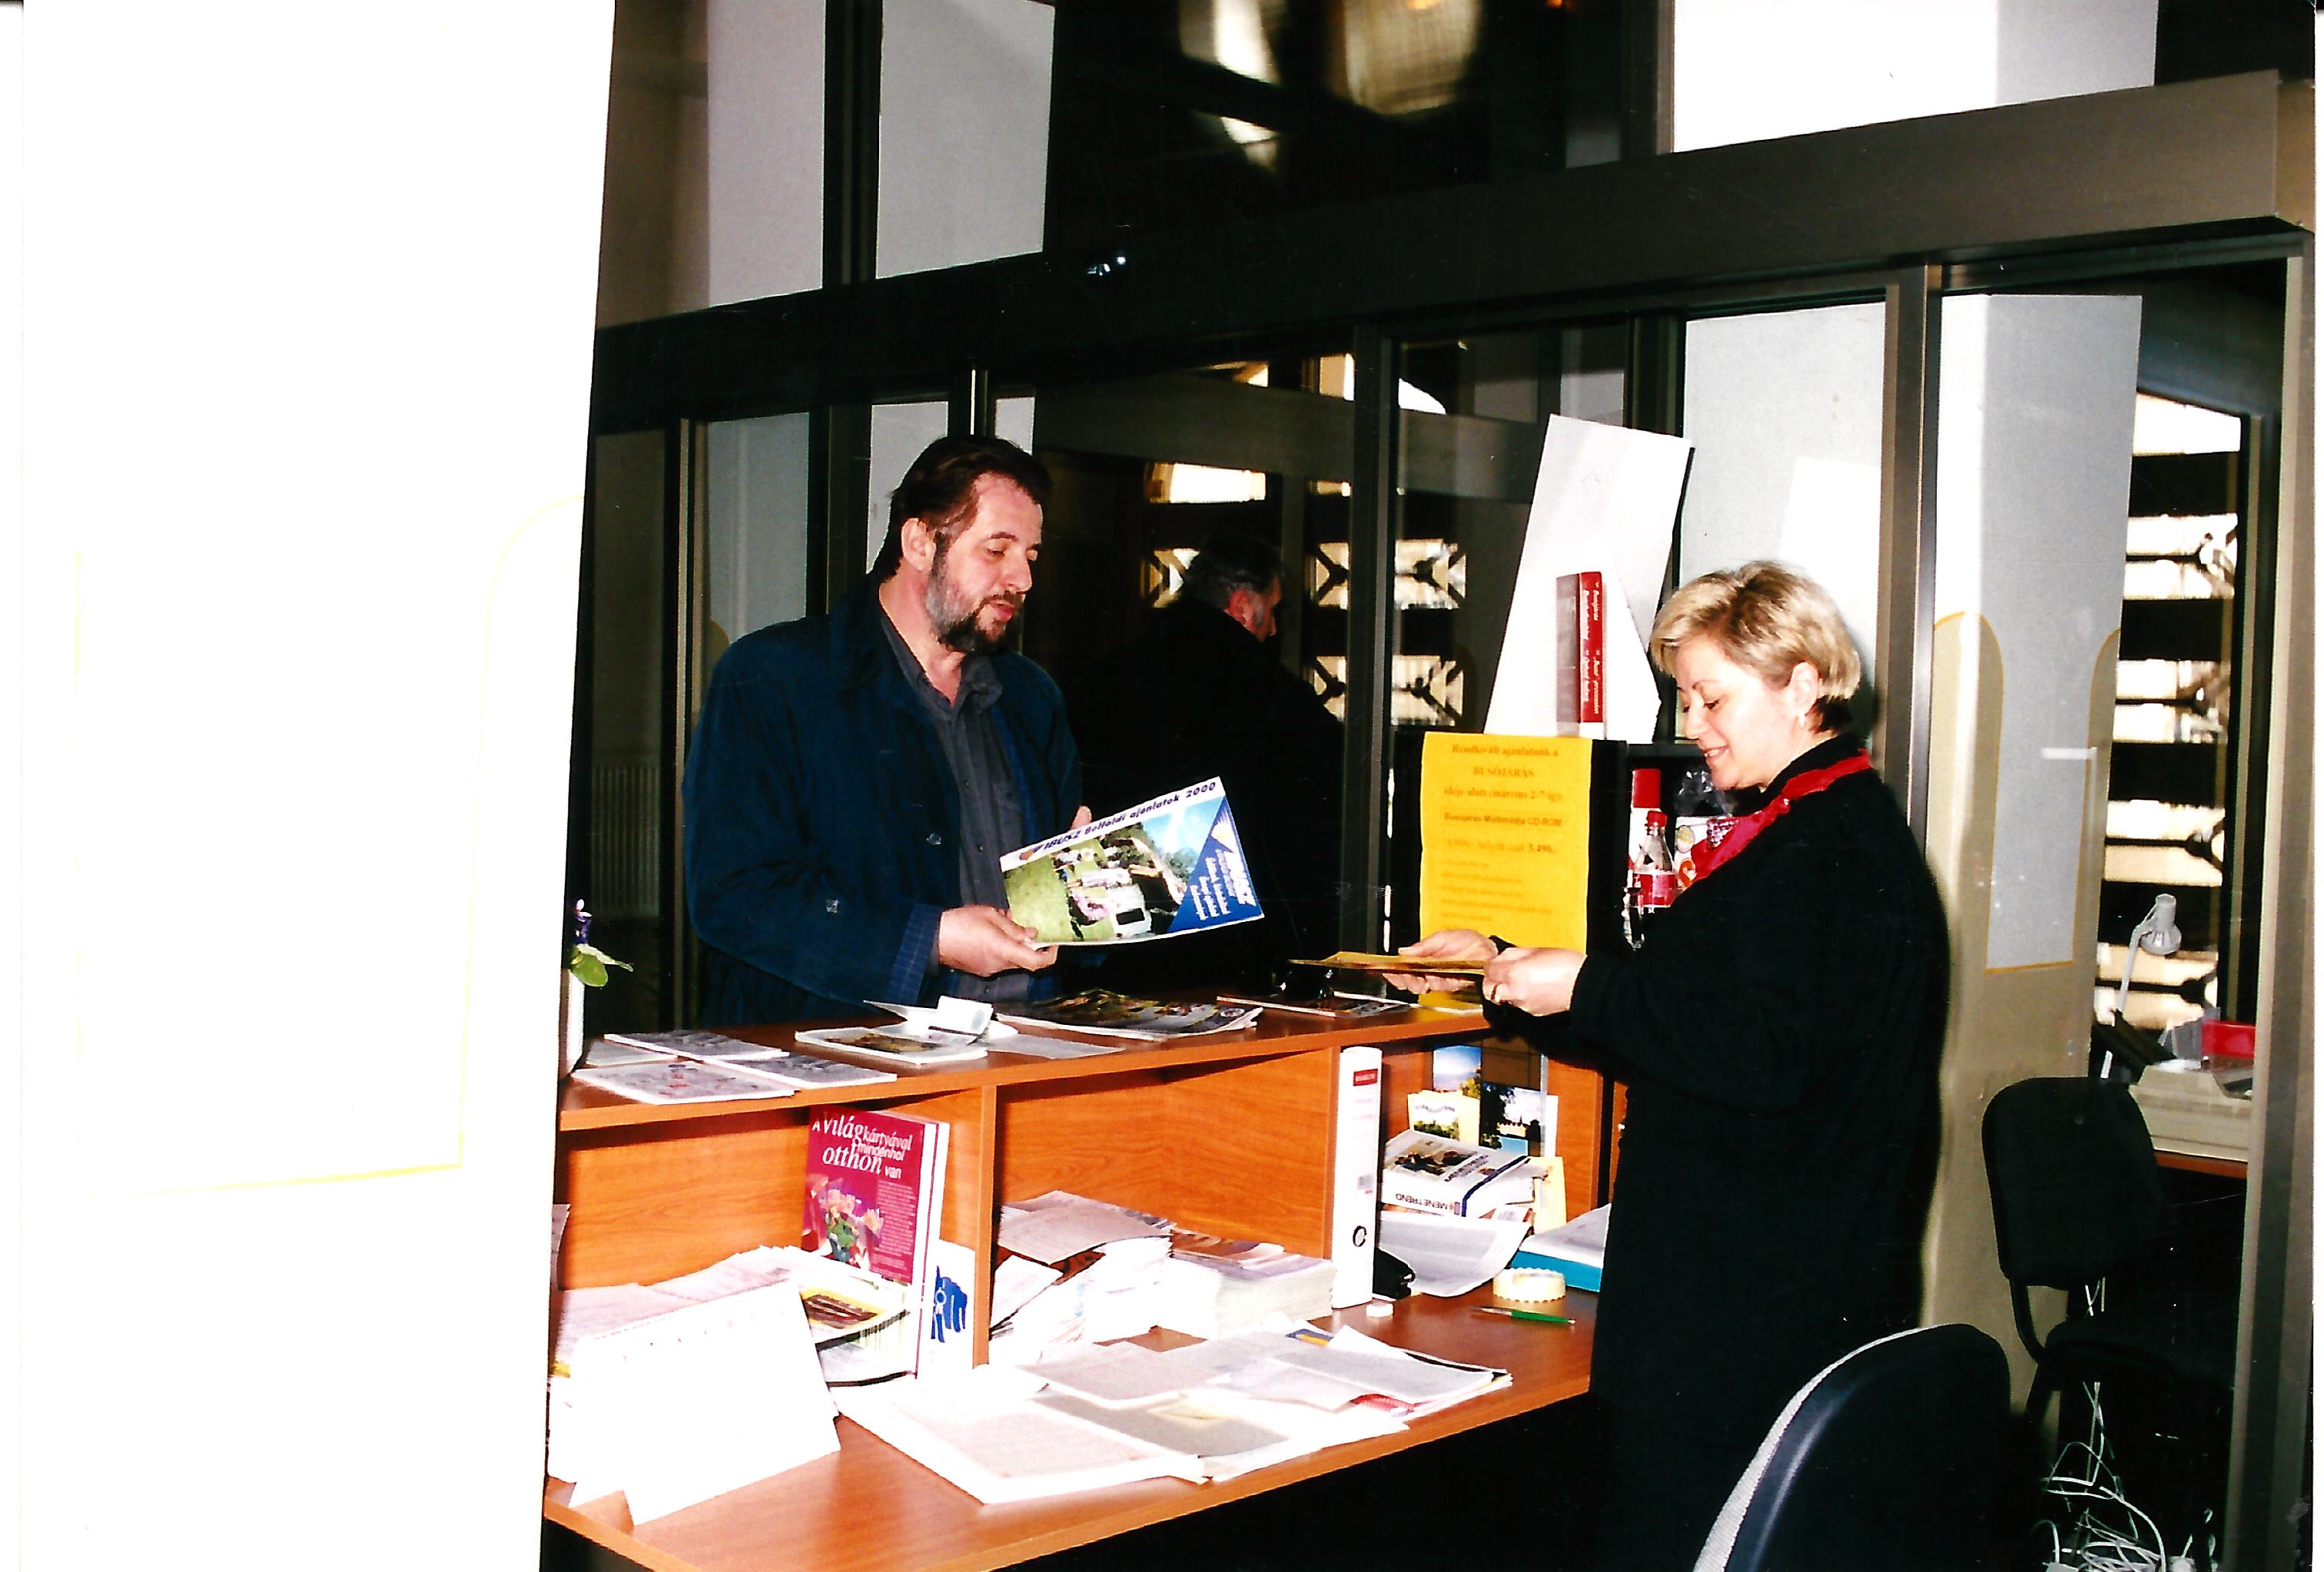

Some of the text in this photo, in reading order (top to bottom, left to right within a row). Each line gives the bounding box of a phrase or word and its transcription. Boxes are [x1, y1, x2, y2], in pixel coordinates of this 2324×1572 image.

[1186, 781, 1216, 799] 2000
[812, 1120, 821, 1132] A
[822, 1145, 901, 1179] otthon van
